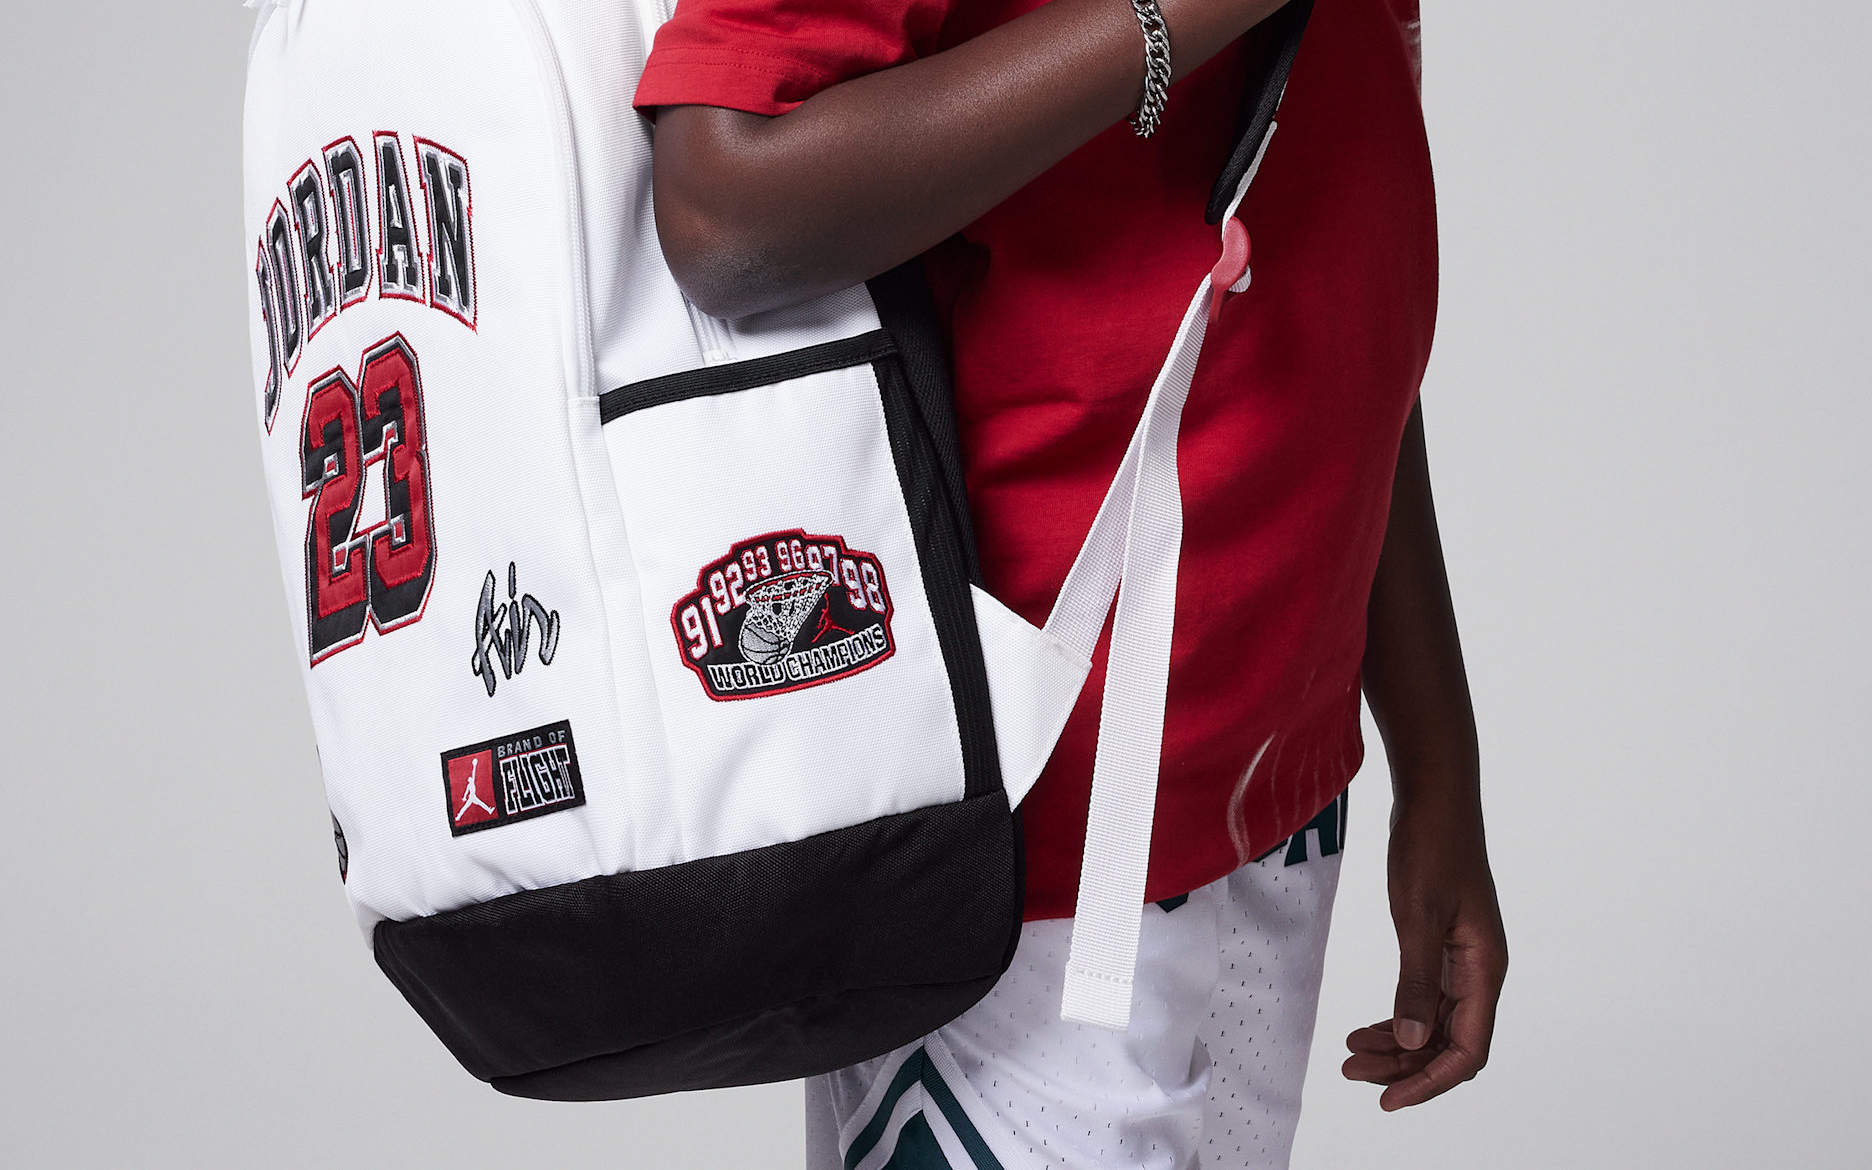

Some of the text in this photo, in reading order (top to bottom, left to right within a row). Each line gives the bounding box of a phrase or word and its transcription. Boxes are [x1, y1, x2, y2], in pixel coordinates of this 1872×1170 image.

[256, 130, 477, 435] JORDAN
[300, 331, 436, 667] 23
[681, 595, 723, 661] 91
[709, 562, 747, 616] 92
[741, 545, 772, 581] 93
[774, 538, 805, 572] 96
[840, 557, 887, 615] 98
[707, 623, 887, 691] WORLD CHAMPIONS
[497, 730, 566, 757] BRAND OF
[499, 744, 576, 815] FLIGHT
